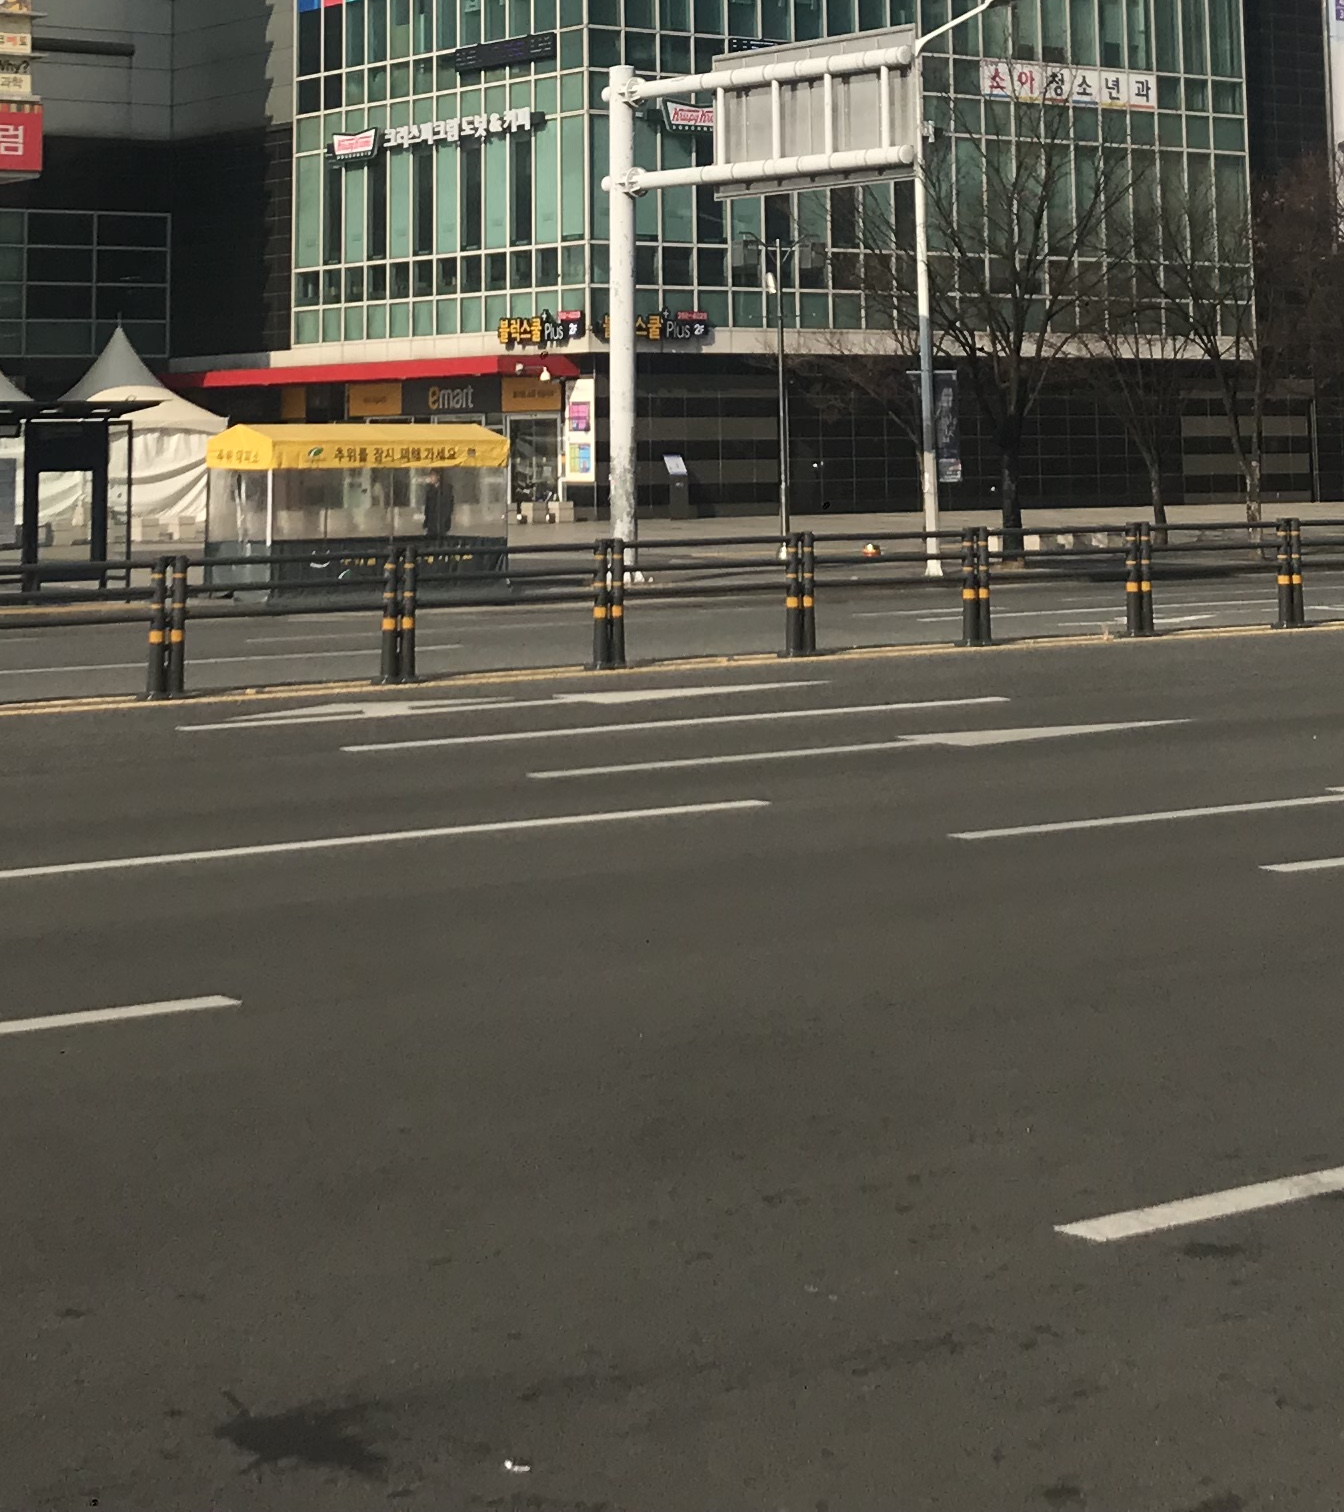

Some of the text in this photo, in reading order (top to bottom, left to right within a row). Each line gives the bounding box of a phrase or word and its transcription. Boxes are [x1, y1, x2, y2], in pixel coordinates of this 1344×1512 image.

[988, 67, 1152, 103] 소아청소년과
[544, 320, 564, 340] Plus
[666, 320, 691, 339] Plus
[428, 384, 474, 411] emart
